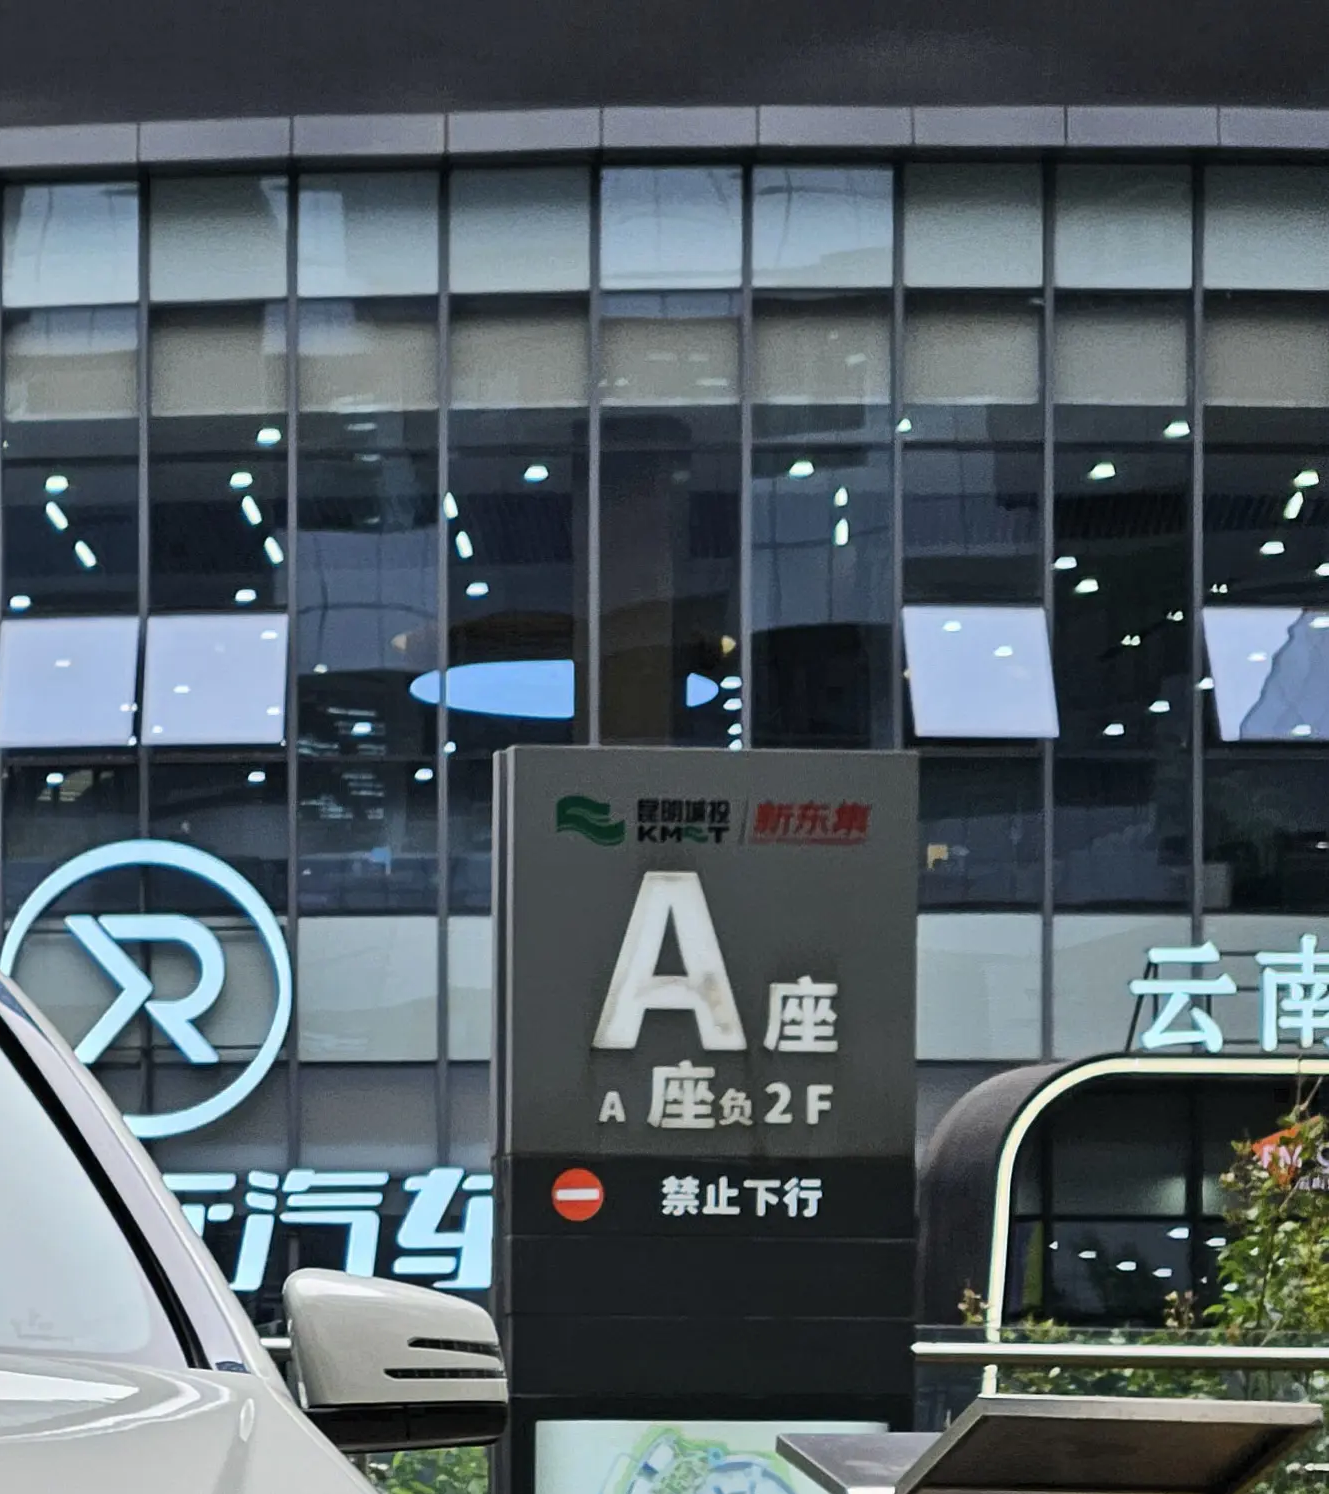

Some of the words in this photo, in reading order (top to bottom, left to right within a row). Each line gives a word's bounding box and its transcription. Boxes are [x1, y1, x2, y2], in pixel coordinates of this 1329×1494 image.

[1129, 933, 1329, 1053] 云南
[661, 1175, 823, 1218] 禁止下行
